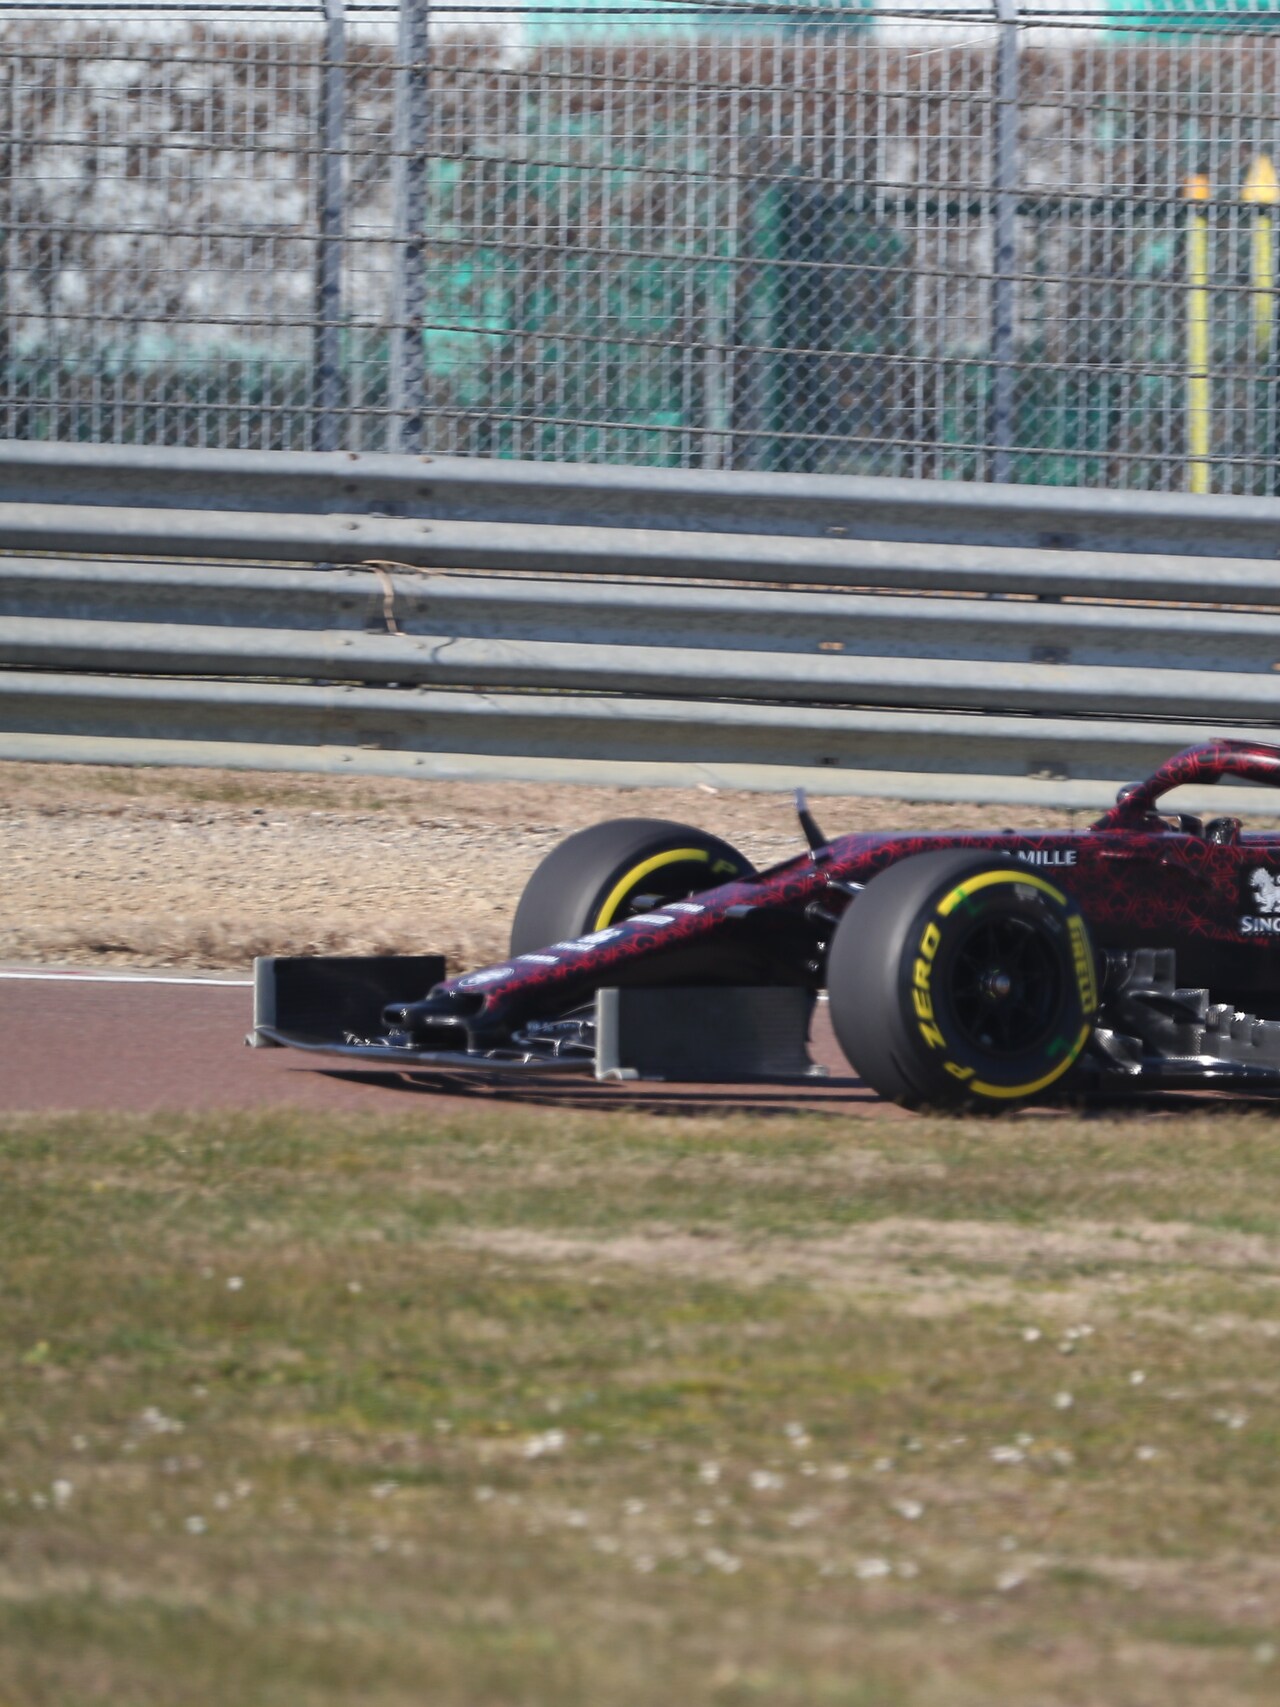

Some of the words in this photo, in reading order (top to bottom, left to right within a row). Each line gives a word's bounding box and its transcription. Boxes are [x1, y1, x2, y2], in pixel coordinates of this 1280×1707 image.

[1018, 849, 1077, 865] MILLE
[911, 922, 946, 1049] ZERO
[1067, 915, 1098, 1014] PIRELLI
